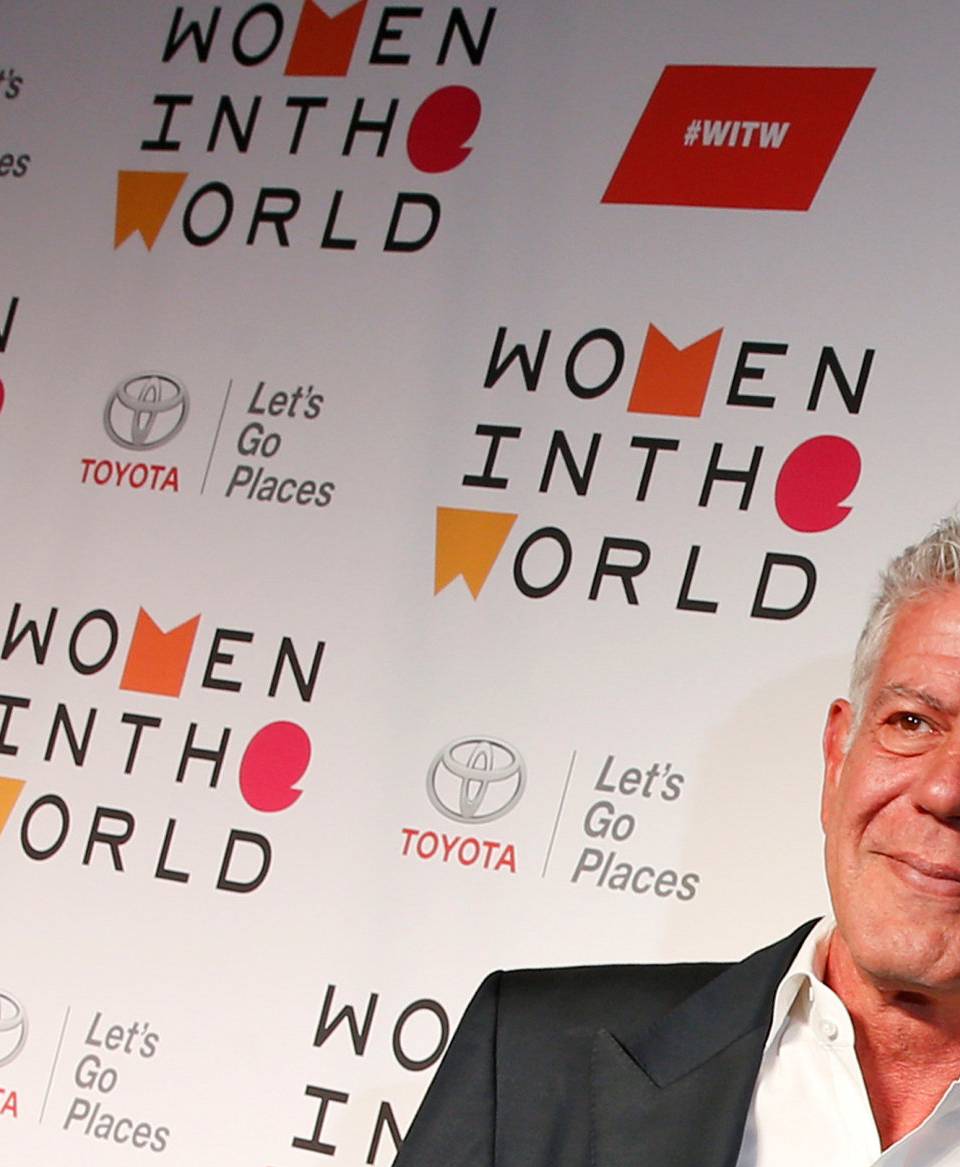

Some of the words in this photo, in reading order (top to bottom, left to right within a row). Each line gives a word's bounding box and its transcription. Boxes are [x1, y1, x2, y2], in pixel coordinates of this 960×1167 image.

[161, 0, 498, 77] WOMEN
[683, 118, 790, 149] #WITW
[114, 170, 441, 253] WORLD
[482, 322, 876, 418] WOMEN
[247, 380, 324, 419] Let's
[237, 421, 282, 458] Go
[80, 458, 180, 492] TOYOTA
[225, 464, 335, 508] Places
[433, 506, 818, 621] WORLD
[0, 601, 326, 703] WOMEN
[594, 754, 685, 802] Let's
[583, 800, 636, 842] Go
[401, 827, 516, 875] TOYOTA
[570, 847, 700, 902] Places
[84, 1012, 160, 1059] Let's
[74, 1054, 118, 1094] Go
[63, 1097, 171, 1153] Places
